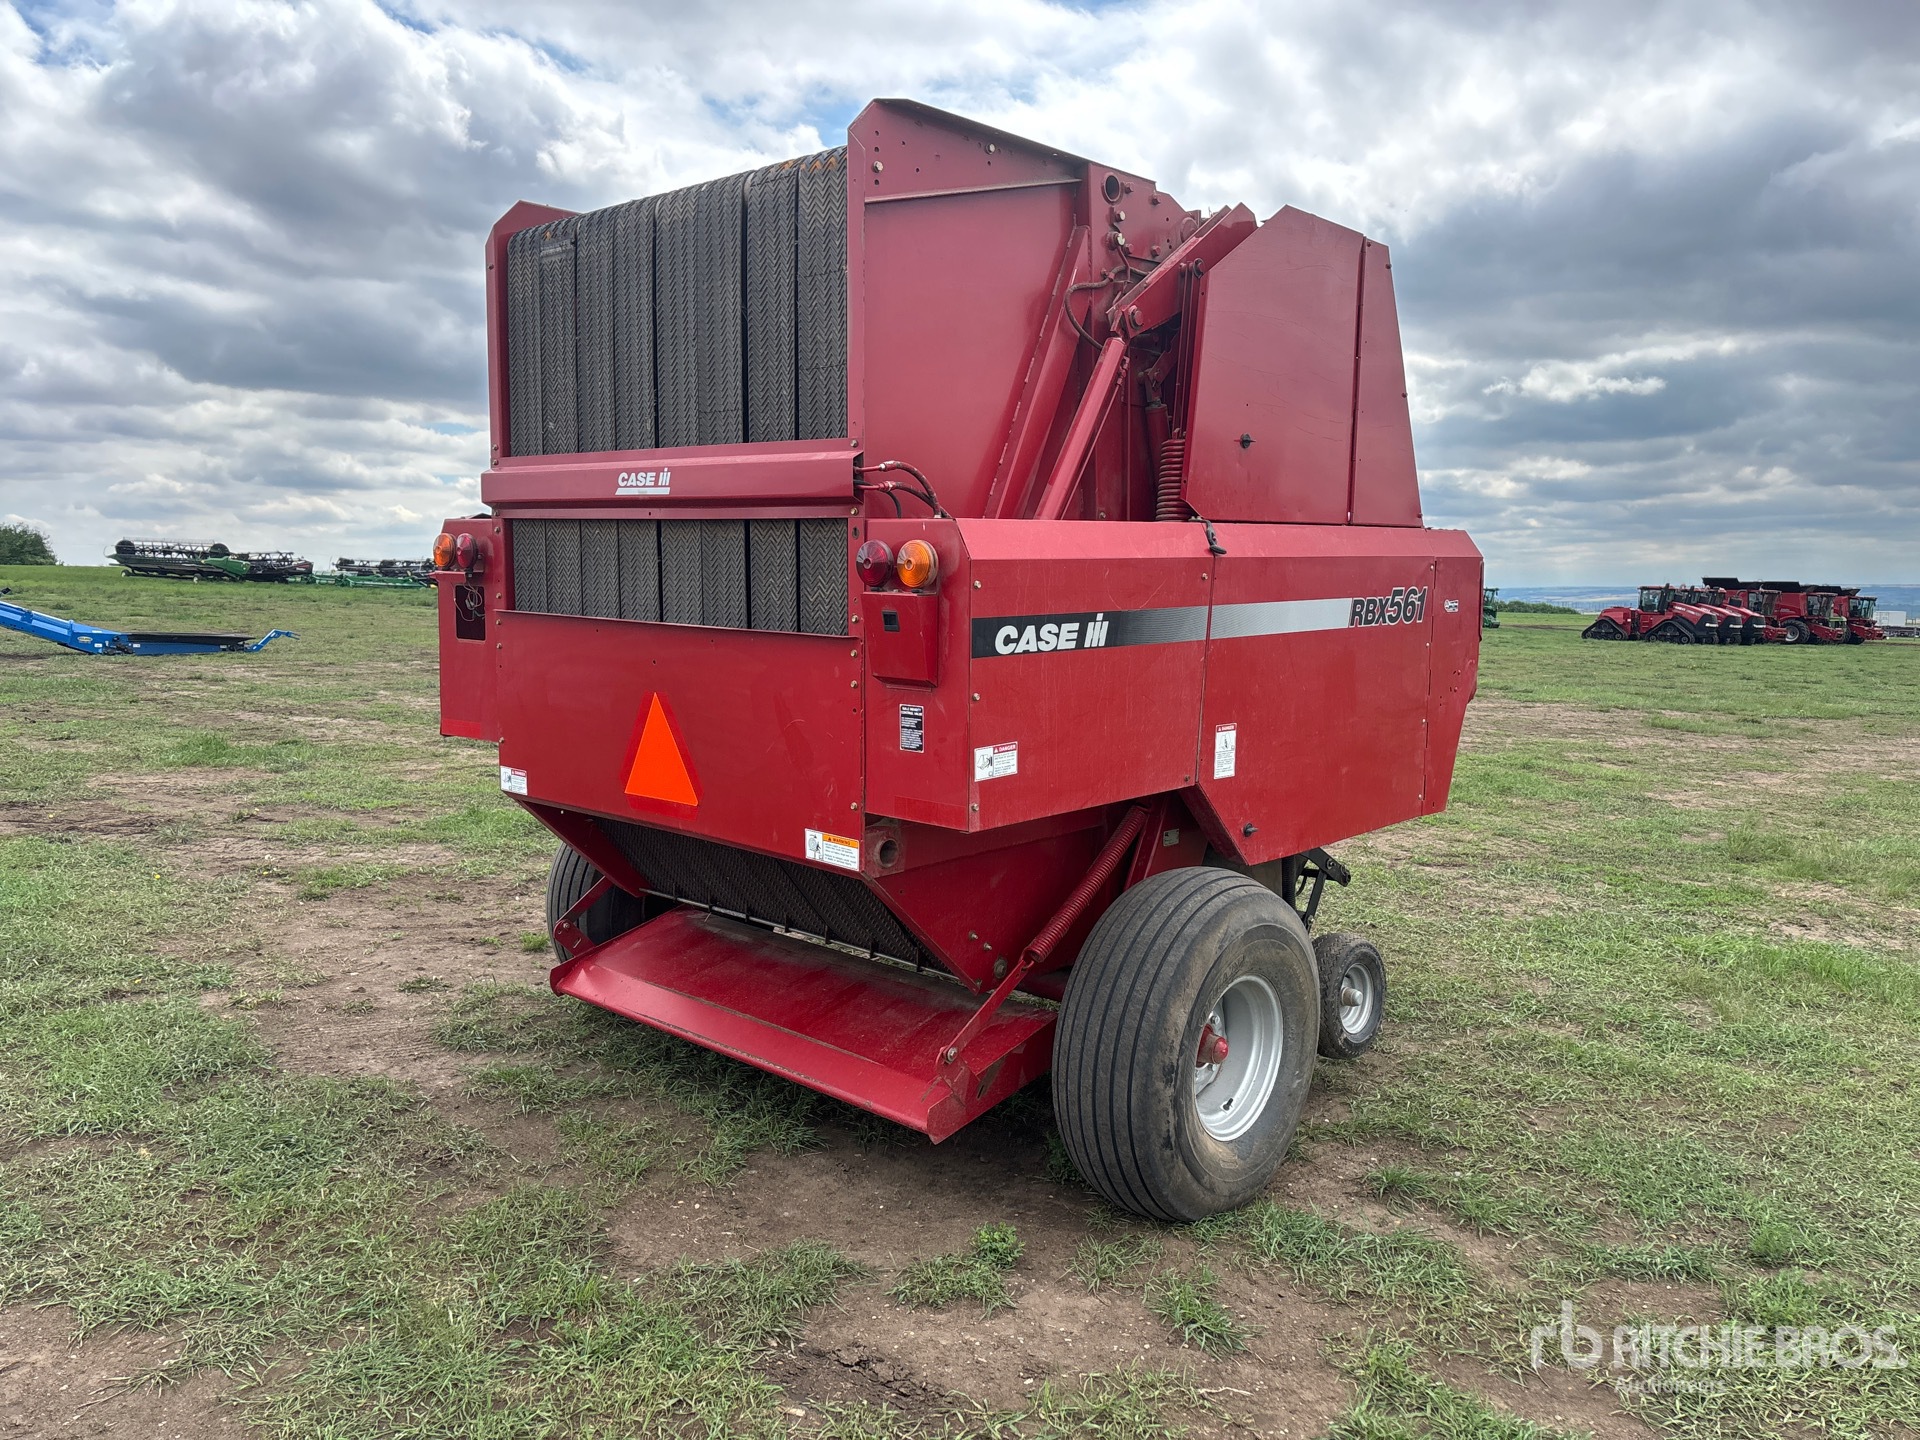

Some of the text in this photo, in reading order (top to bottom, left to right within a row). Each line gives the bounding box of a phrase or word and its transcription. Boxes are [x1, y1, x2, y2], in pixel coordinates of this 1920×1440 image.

[618, 472, 656, 487] CASE
[1348, 586, 1428, 628] RBX561
[995, 623, 1080, 655] CASE
[998, 744, 1016, 752] DANGER
